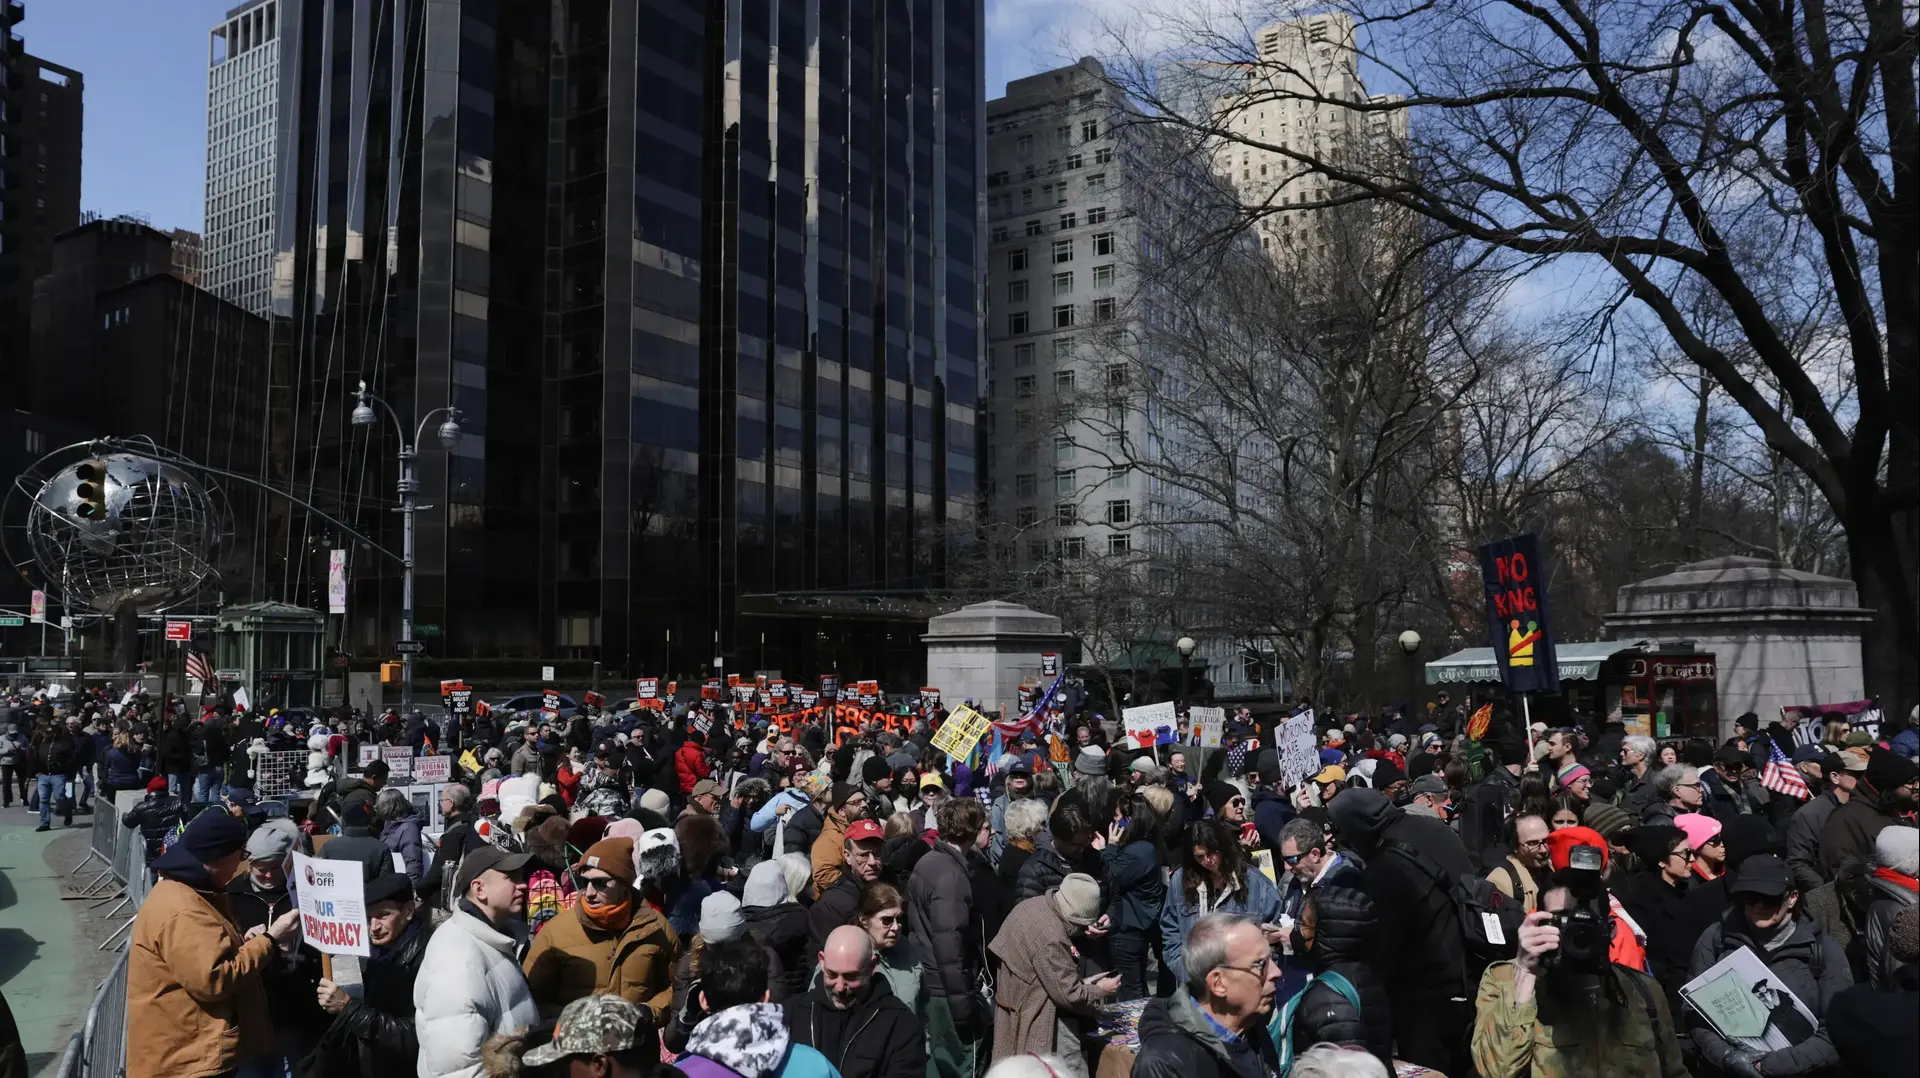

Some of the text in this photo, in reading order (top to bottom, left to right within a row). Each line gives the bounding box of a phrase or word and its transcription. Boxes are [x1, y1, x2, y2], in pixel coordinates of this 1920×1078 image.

[1495, 553, 1528, 586] NO
[1493, 587, 1537, 618] KNG
[1466, 668, 1499, 678] AUTHENT
[1128, 712, 1174, 724] MONSTERS
[1280, 720, 1309, 745] MORONS
[416, 763, 449, 771] ORIGINAL
[422, 769, 446, 777] PHOTOS
[316, 877, 335, 887] OFF!
[314, 899, 336, 917] OUR
[303, 913, 361, 947] DEMOCRACY
